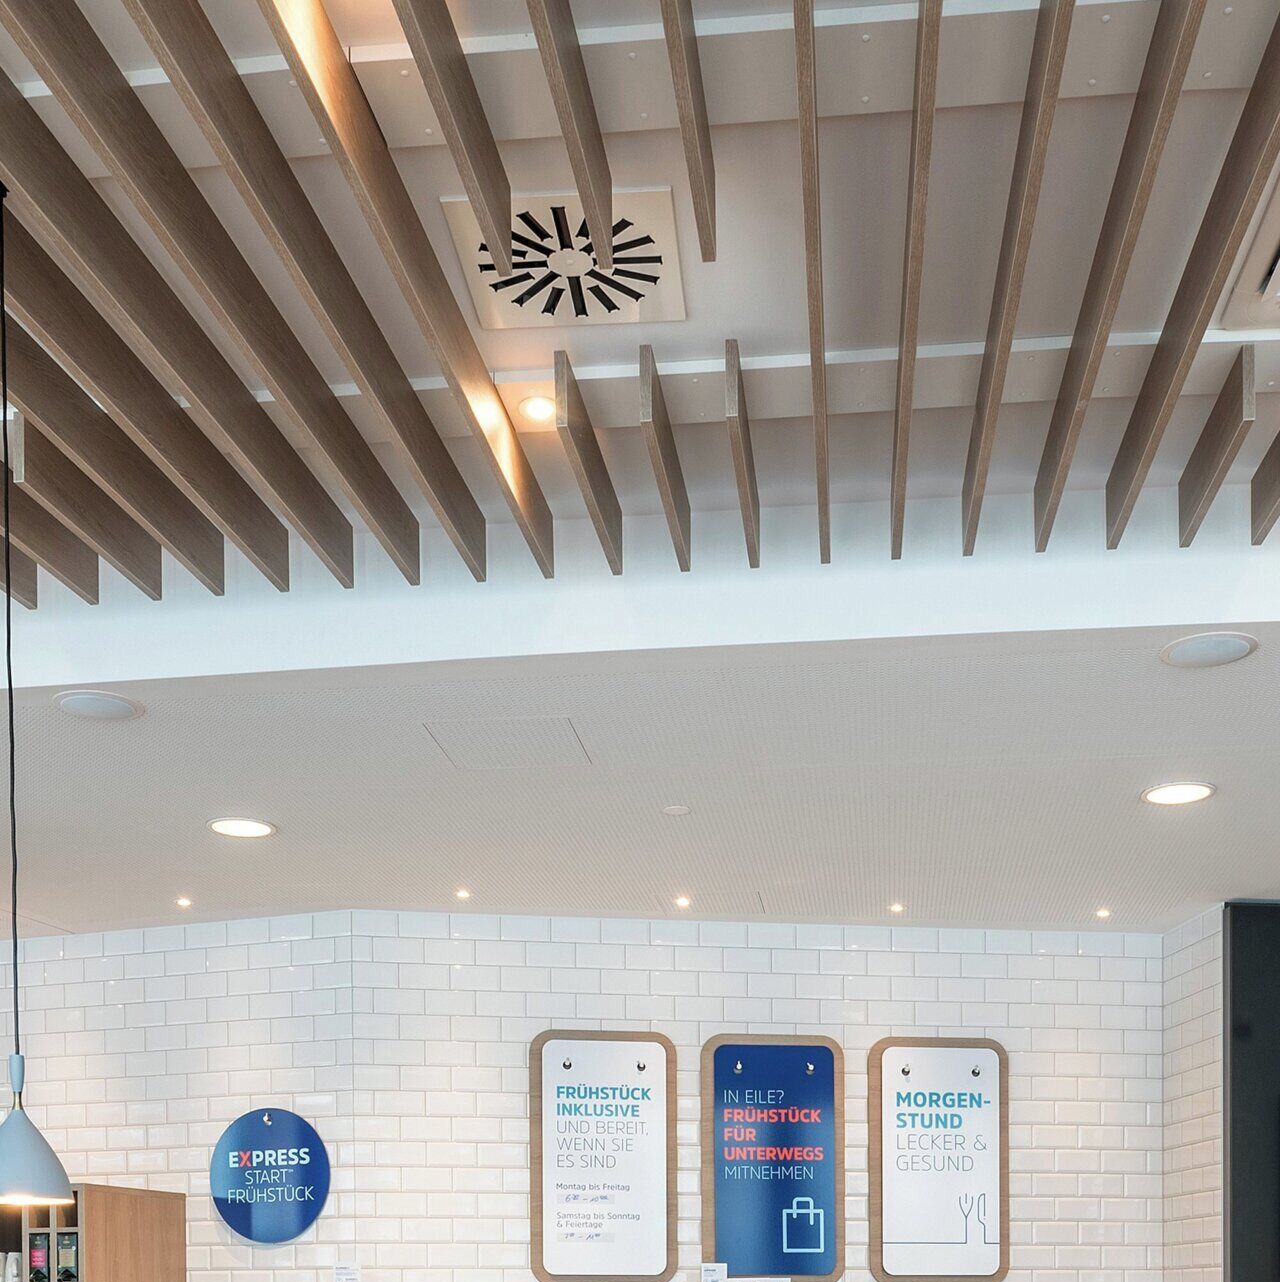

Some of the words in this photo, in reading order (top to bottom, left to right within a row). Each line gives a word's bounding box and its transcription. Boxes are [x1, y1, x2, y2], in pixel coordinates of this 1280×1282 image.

[556, 1083, 652, 1100] FRÜHSTÜCK
[723, 1089, 739, 1104] IN
[745, 1089, 785, 1104] EILE?
[896, 1091, 991, 1108] MORGEN-
[556, 1102, 640, 1117] INKLUSIVE
[723, 1106, 822, 1123] FRÜHSTÜCK
[556, 1120, 590, 1134] UND
[595, 1120, 649, 1137] BEREIT,
[896, 1112, 963, 1129] STUND
[723, 1125, 757, 1141] FÜR
[556, 1137, 606, 1151] WENN
[611, 1138, 634, 1152] SIE
[896, 1133, 966, 1150] LECKER
[973, 1134, 987, 1151] &
[228, 1148, 311, 1168] EXPRESS
[556, 1154, 575, 1168] ES
[580, 1154, 617, 1169] SIND
[723, 1147, 824, 1161] UNTERWEGS
[896, 1154, 974, 1172] GESUND
[724, 1165, 814, 1180] MITNEHMEN
[227, 1184, 314, 1204] FRÜHSTÜCK
[555, 1182, 587, 1191] Montag
[589, 1183, 600, 1191] bis
[602, 1183, 631, 1191] Freitag
[556, 1212, 591, 1220] Samstag
[593, 1212, 605, 1220] bis
[607, 1212, 640, 1221] Sonntag
